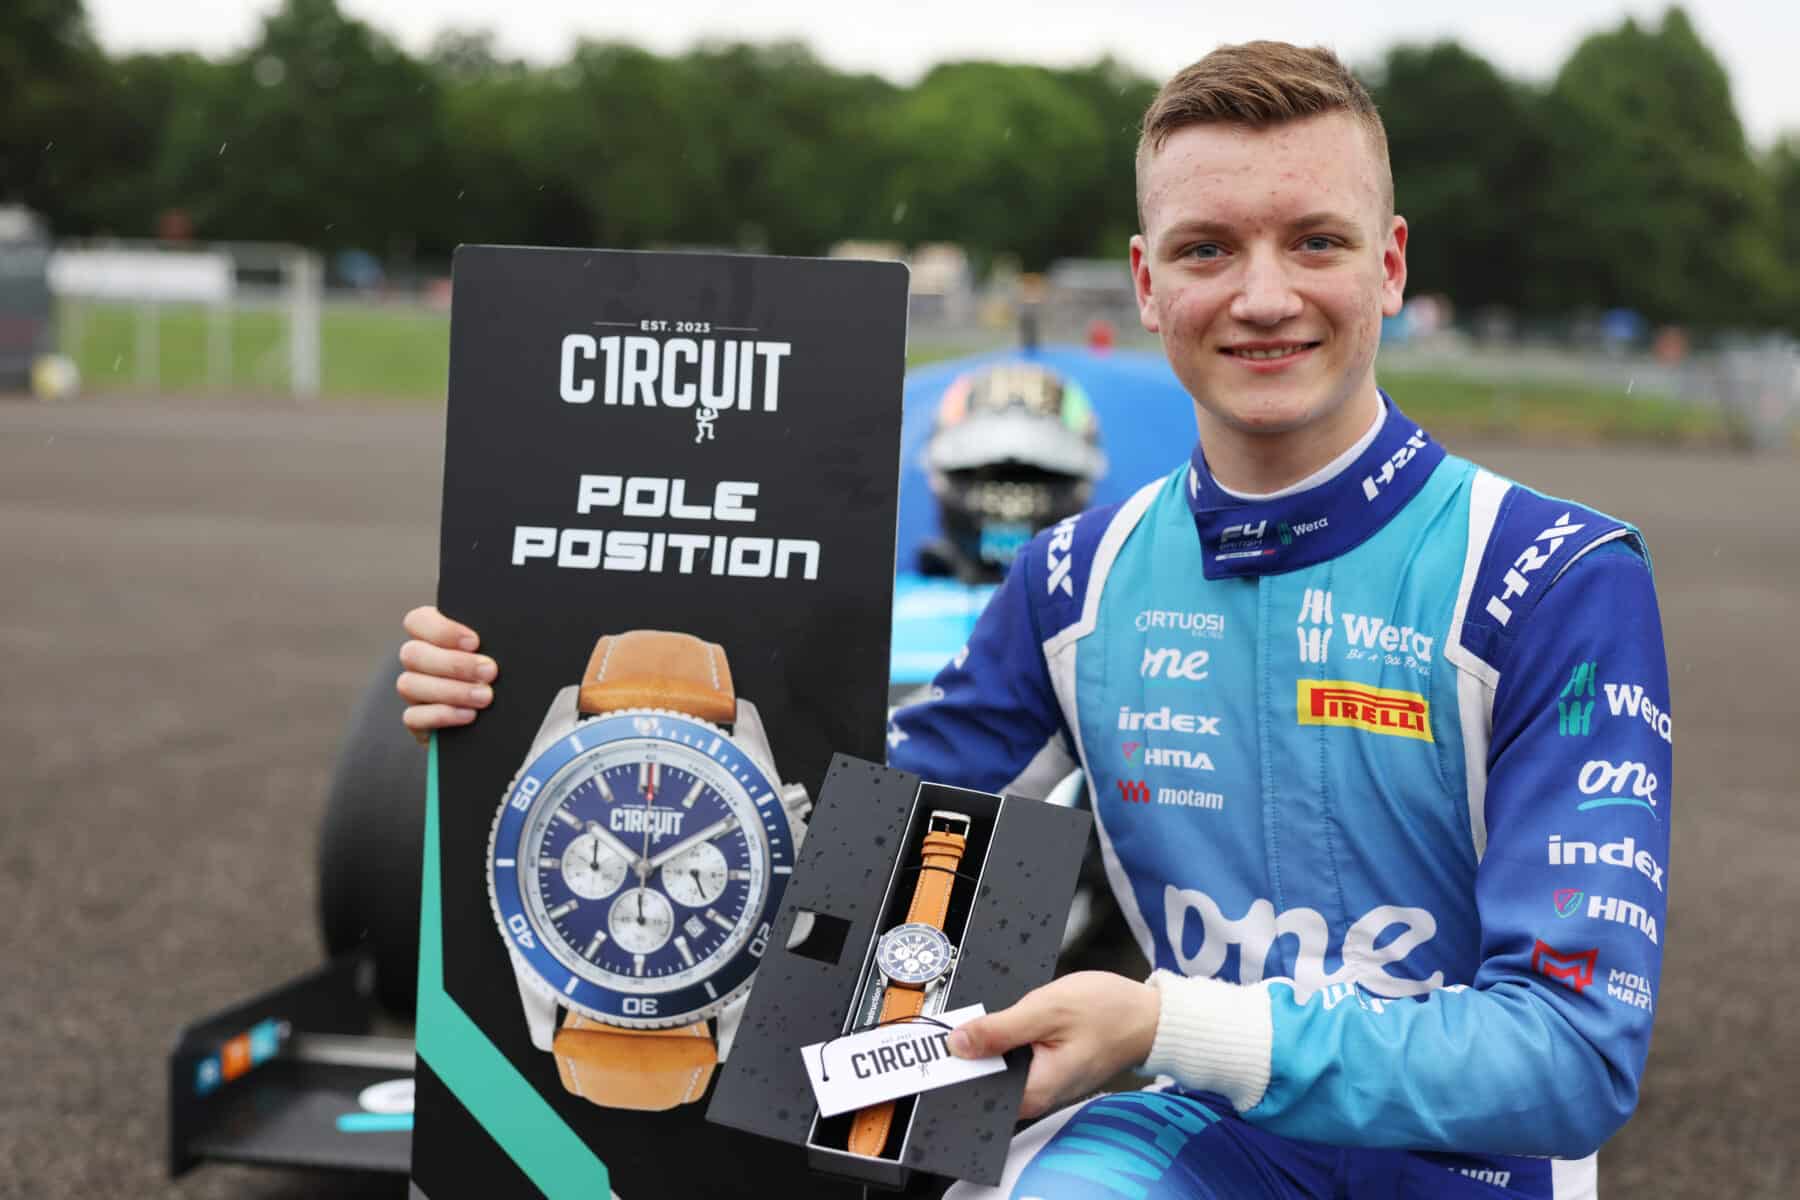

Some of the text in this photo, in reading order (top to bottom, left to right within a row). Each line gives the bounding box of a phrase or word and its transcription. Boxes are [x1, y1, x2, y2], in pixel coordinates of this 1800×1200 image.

[640, 319, 711, 334] EST. 2023
[560, 333, 792, 412] C1RCUIT
[577, 474, 760, 522] POLE
[1292, 516, 1329, 537] Wera
[511, 526, 821, 581] POSITION
[1485, 510, 1587, 628] HRX
[1341, 612, 1434, 663] Wera
[1310, 687, 1426, 733] PIRELLI
[1603, 683, 1673, 744] Wera
[1144, 748, 1216, 771] HMA
[1578, 760, 1659, 807] one
[1157, 788, 1224, 811] motam
[1548, 834, 1665, 893] index
[1163, 884, 1446, 1006] one
[1587, 895, 1659, 946] HMA
